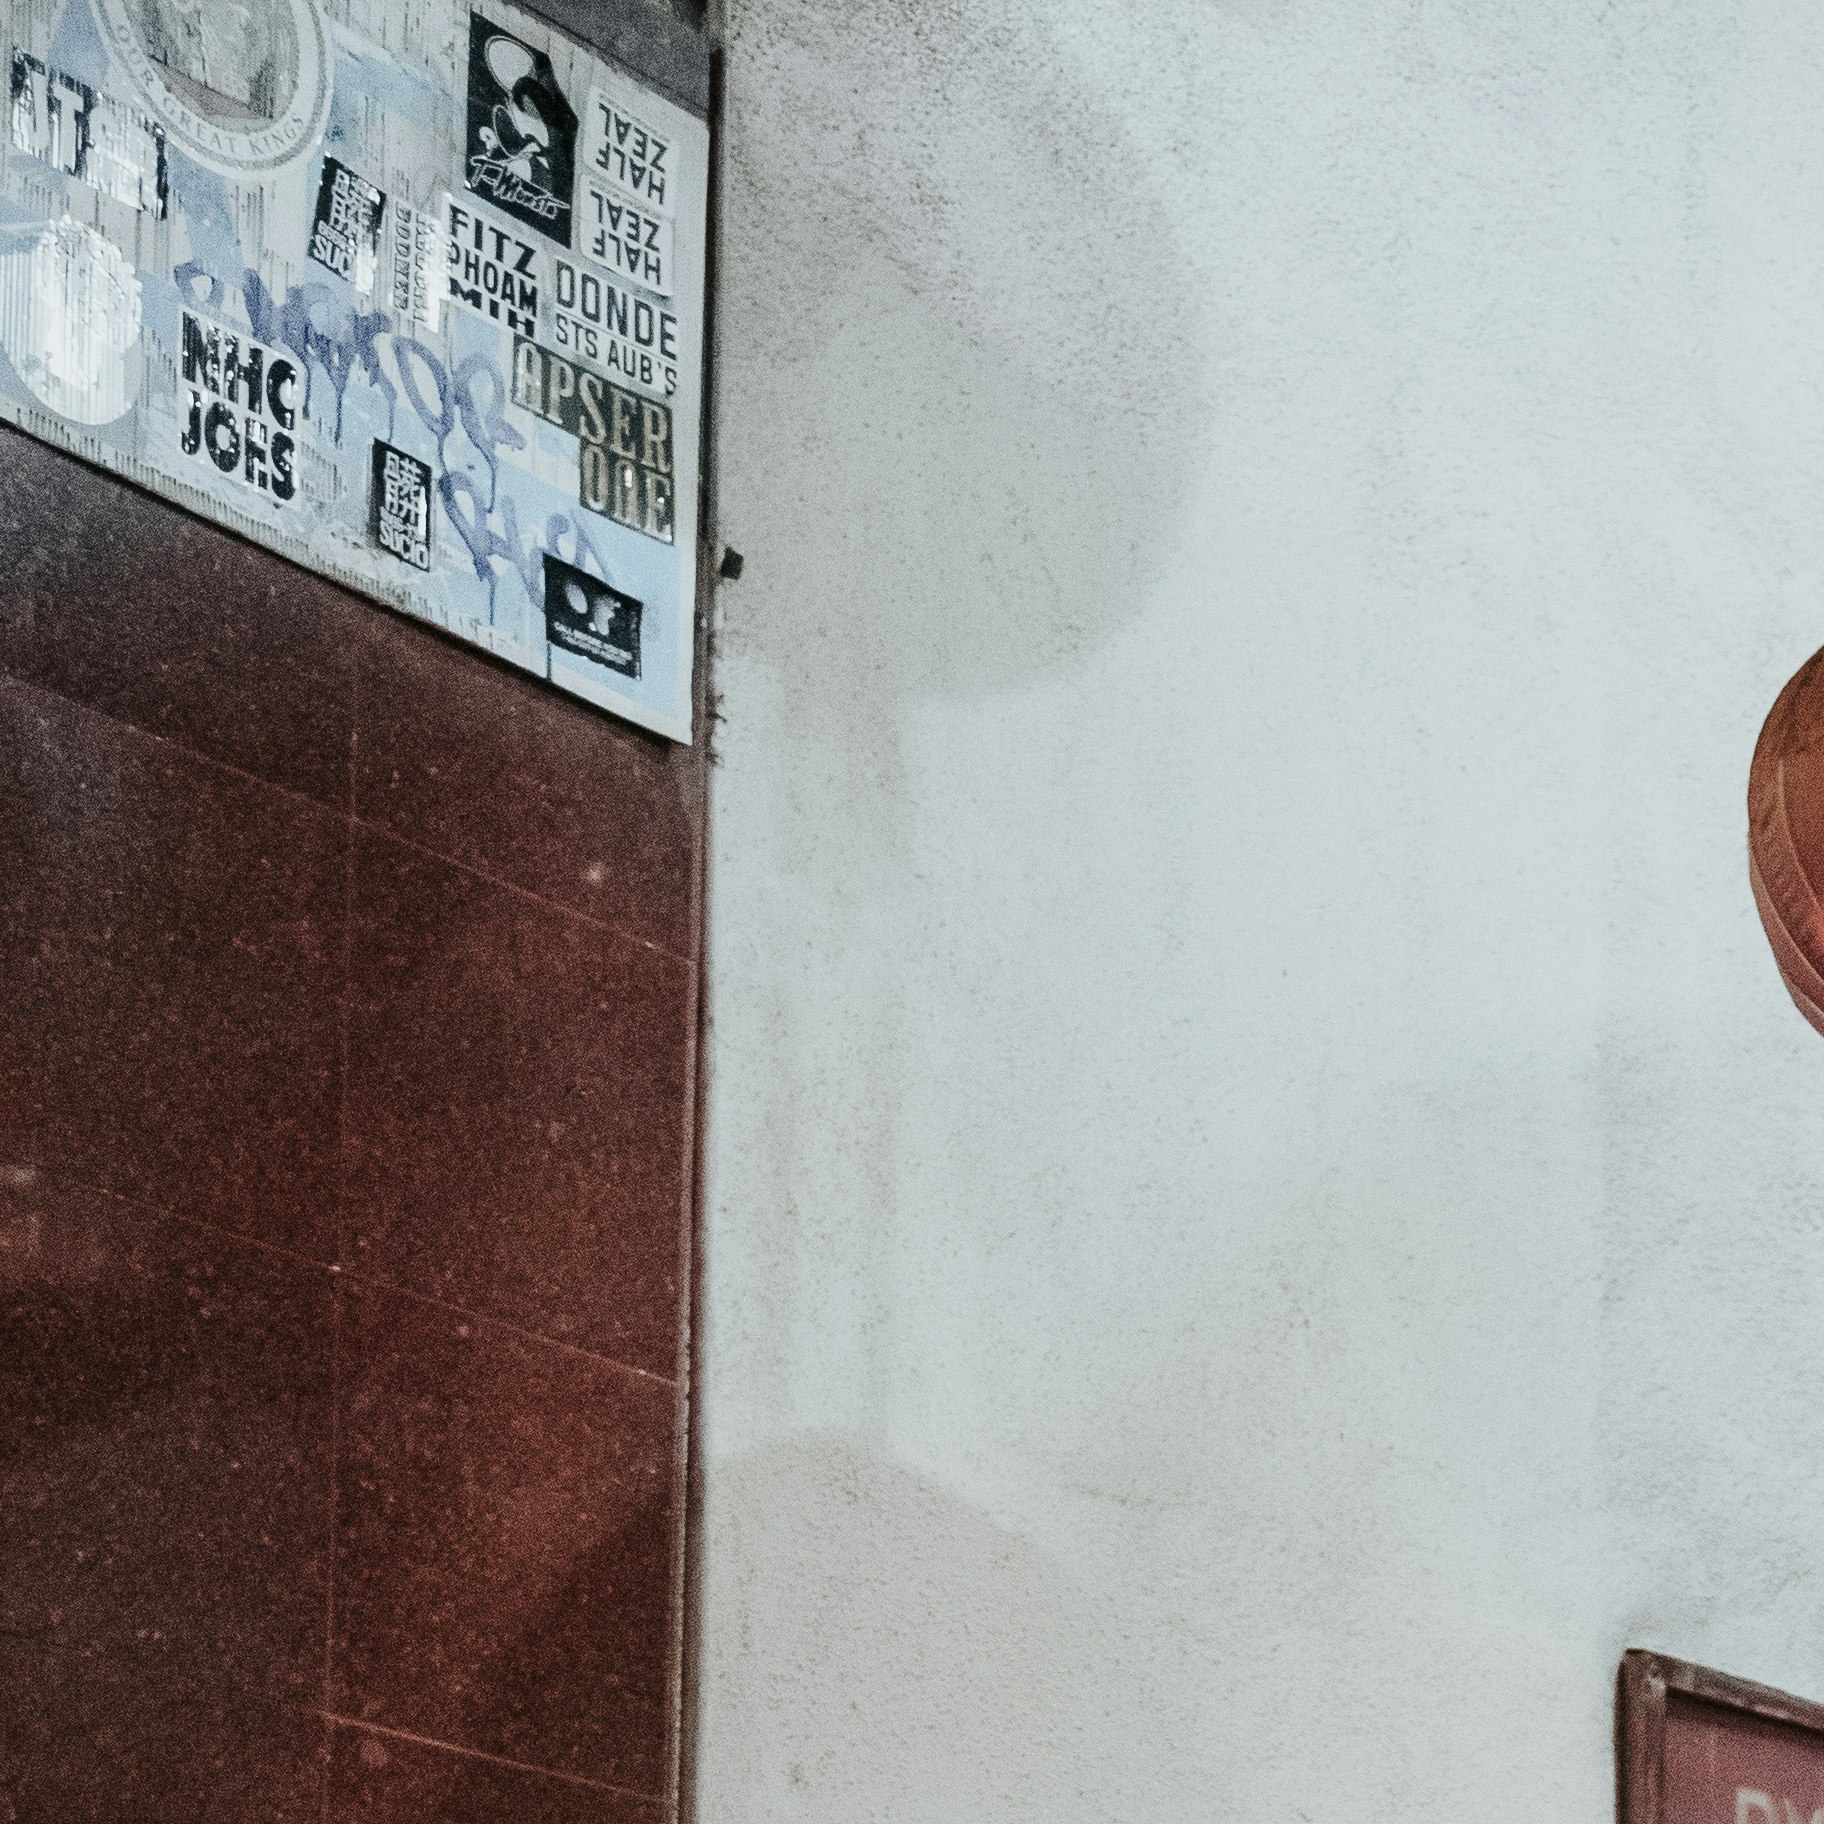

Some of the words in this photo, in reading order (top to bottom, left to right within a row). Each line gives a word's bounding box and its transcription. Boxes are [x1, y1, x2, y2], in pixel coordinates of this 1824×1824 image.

[162, 96, 237, 155] GREAT
[248, 115, 305, 157] KINGS
[598, 101, 668, 174] ZEAL
[595, 141, 666, 206] HALF
[450, 205, 537, 281] FITZ
[590, 189, 661, 253] ZEAL
[592, 229, 661, 286] HALF
[556, 259, 677, 361] DONDE
[556, 312, 598, 360] STS
[514, 341, 674, 475] APSER
